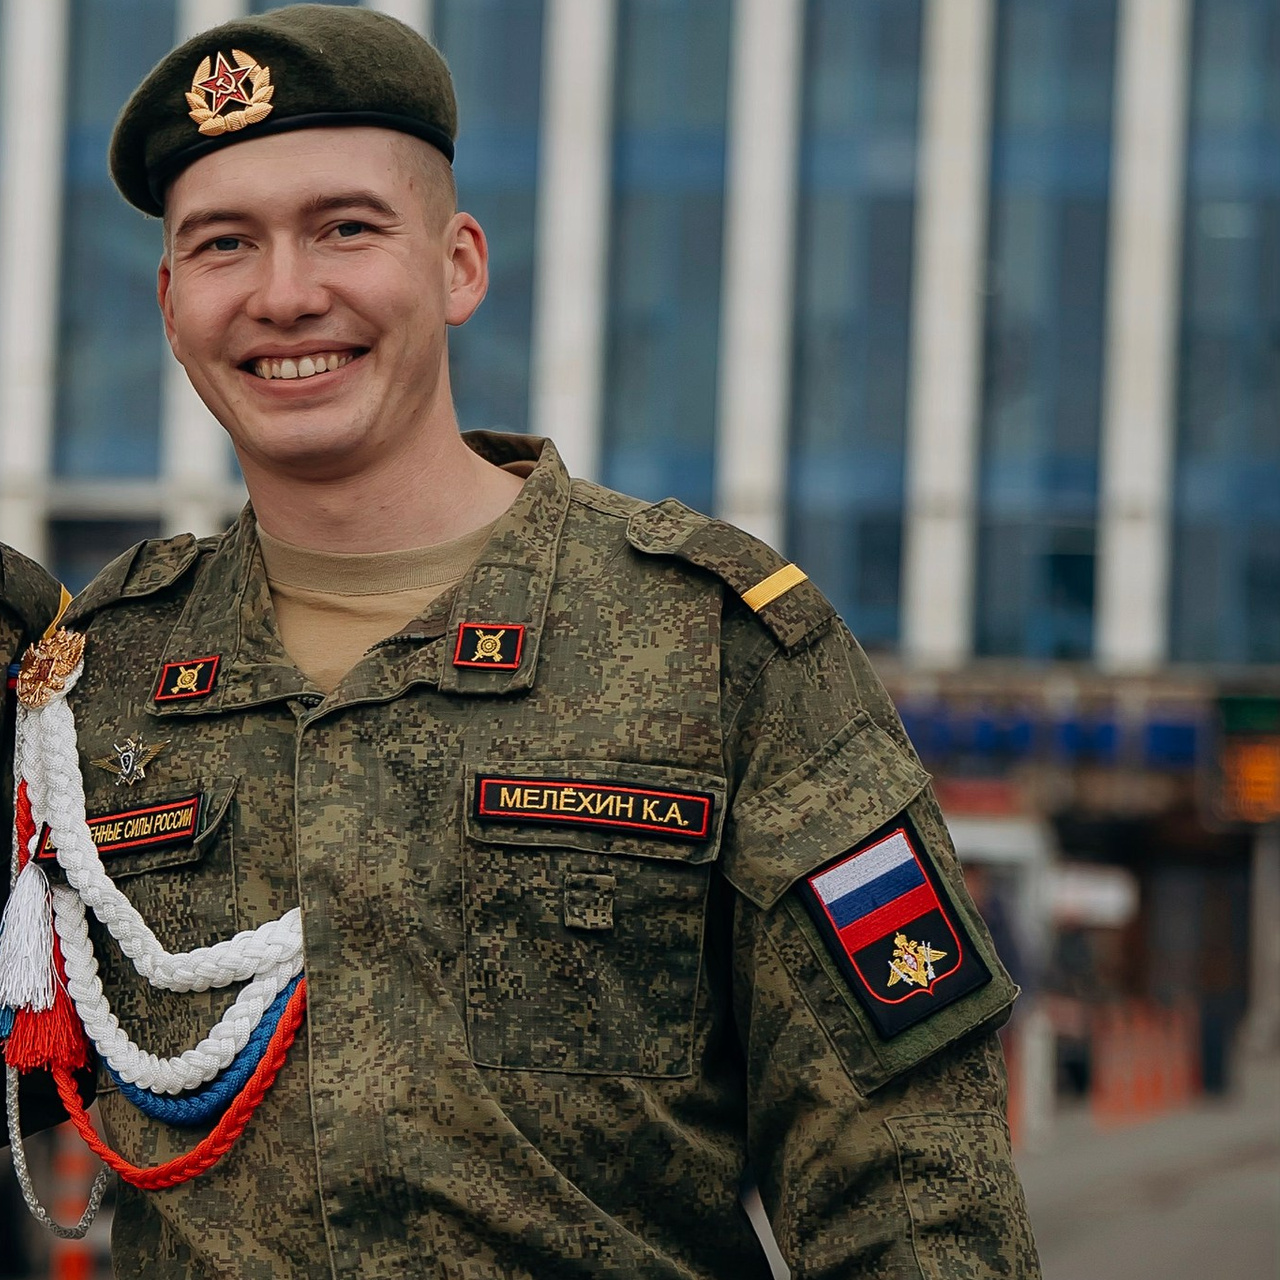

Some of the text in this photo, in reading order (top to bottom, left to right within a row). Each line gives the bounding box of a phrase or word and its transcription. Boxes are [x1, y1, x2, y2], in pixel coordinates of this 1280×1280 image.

[124, 816, 154, 839] СИЛЫ
[154, 807, 193, 833] РОССИИ
[500, 786, 689, 826] МЕЛЁХИН К.А.
